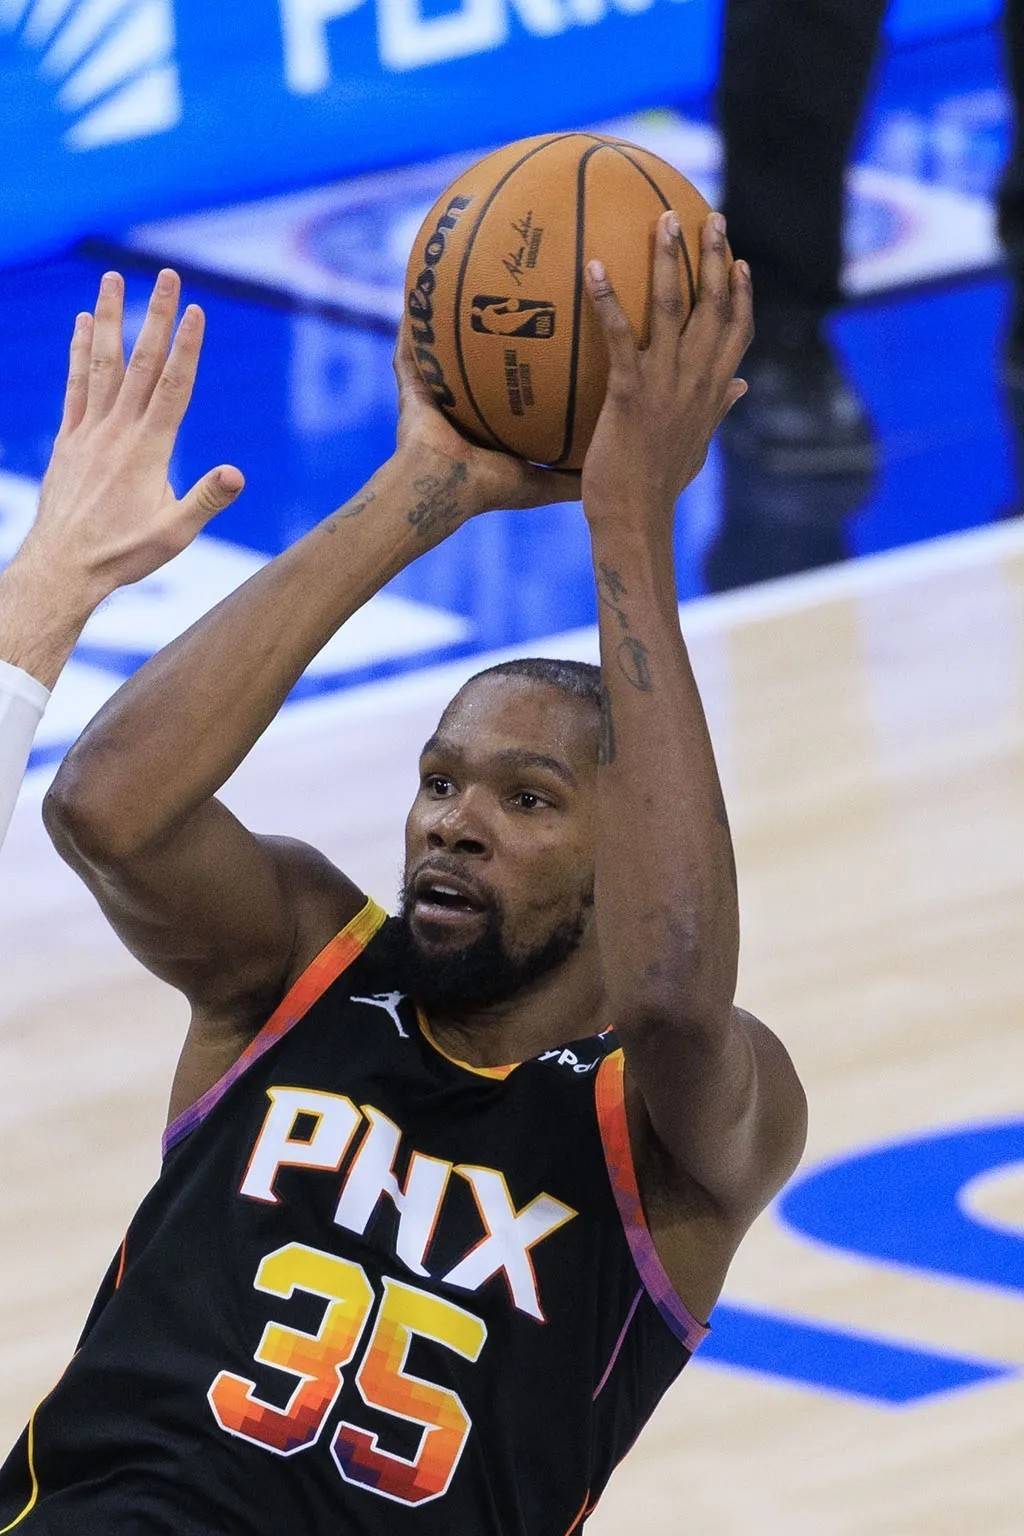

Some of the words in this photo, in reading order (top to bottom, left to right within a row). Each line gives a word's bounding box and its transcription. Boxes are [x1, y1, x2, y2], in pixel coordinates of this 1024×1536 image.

[408, 194, 472, 408] Wilson
[239, 1085, 579, 1324] PNX
[207, 1242, 488, 1508] 35
